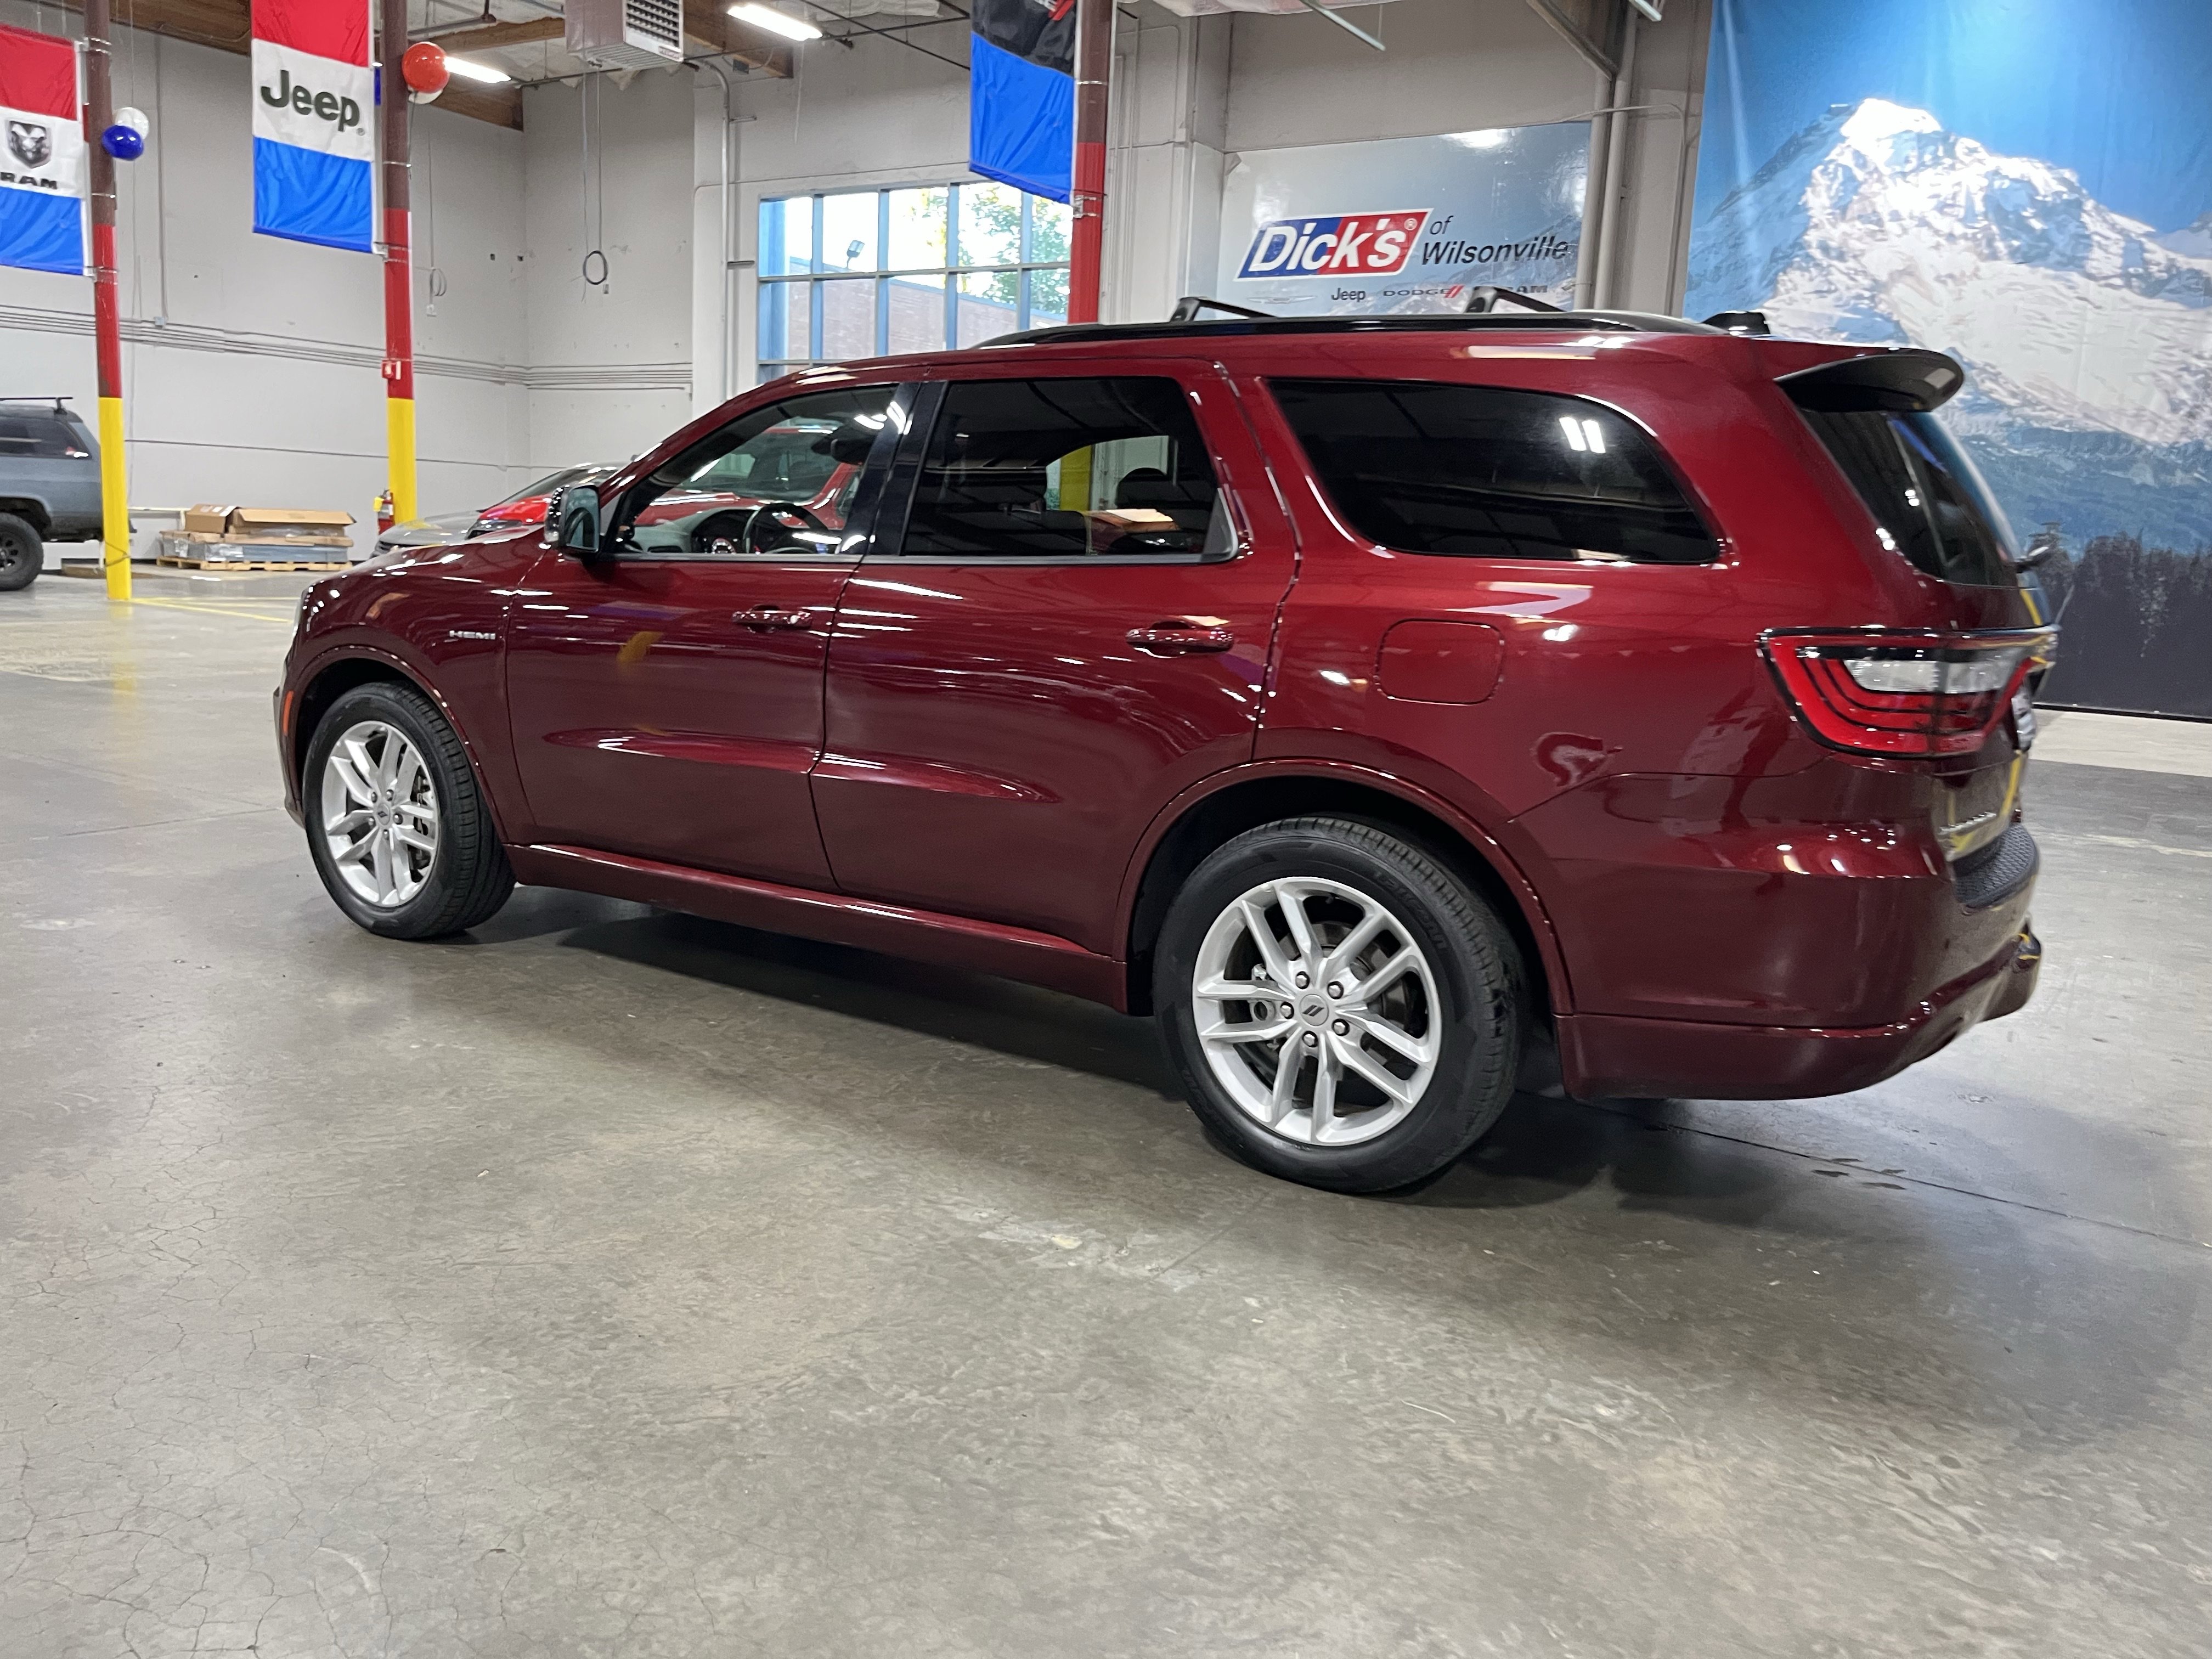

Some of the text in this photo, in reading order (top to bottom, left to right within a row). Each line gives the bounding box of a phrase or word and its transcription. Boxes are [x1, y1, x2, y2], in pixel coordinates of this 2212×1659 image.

[261, 70, 360, 132] Jeep
[0, 172, 58, 190] RAM
[1429, 216, 1454, 235] of
[1248, 218, 1406, 272] Dick's
[1422, 236, 1568, 265] Wilsonville
[1331, 287, 1365, 302] Jeep
[1383, 288, 1450, 297] DODGE
[449, 630, 496, 640] HEMI
